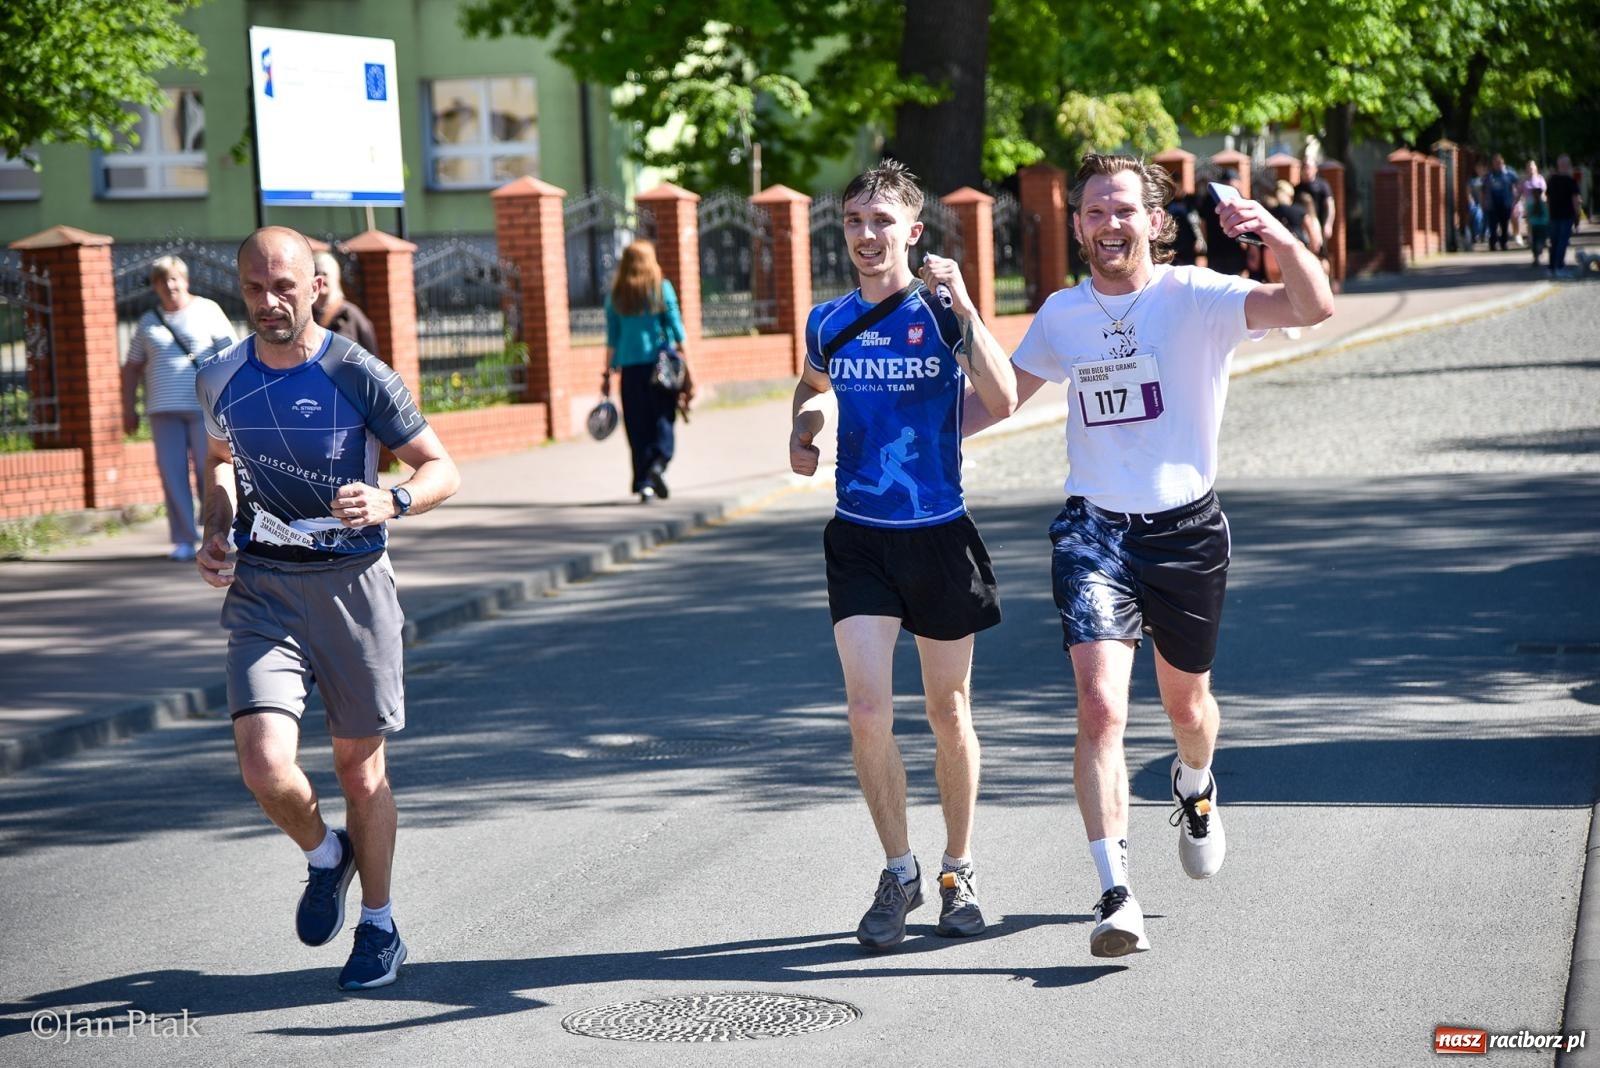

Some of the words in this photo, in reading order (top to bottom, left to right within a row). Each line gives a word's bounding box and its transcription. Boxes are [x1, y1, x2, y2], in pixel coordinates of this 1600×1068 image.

[1078, 367, 1091, 376] XVIII
[1091, 366, 1104, 375] BIEG
[1104, 364, 1115, 373] BEZ
[1115, 361, 1137, 371] GRANIC
[832, 383, 884, 392] KO-OKNA
[887, 383, 915, 392] TEAM
[1095, 388, 1128, 415] 117
[259, 453, 318, 480] DISCOVER
[321, 474, 343, 485] THE
[262, 515, 277, 531] XVIII
[276, 523, 290, 537] BIEG
[290, 531, 302, 542] BEZ
